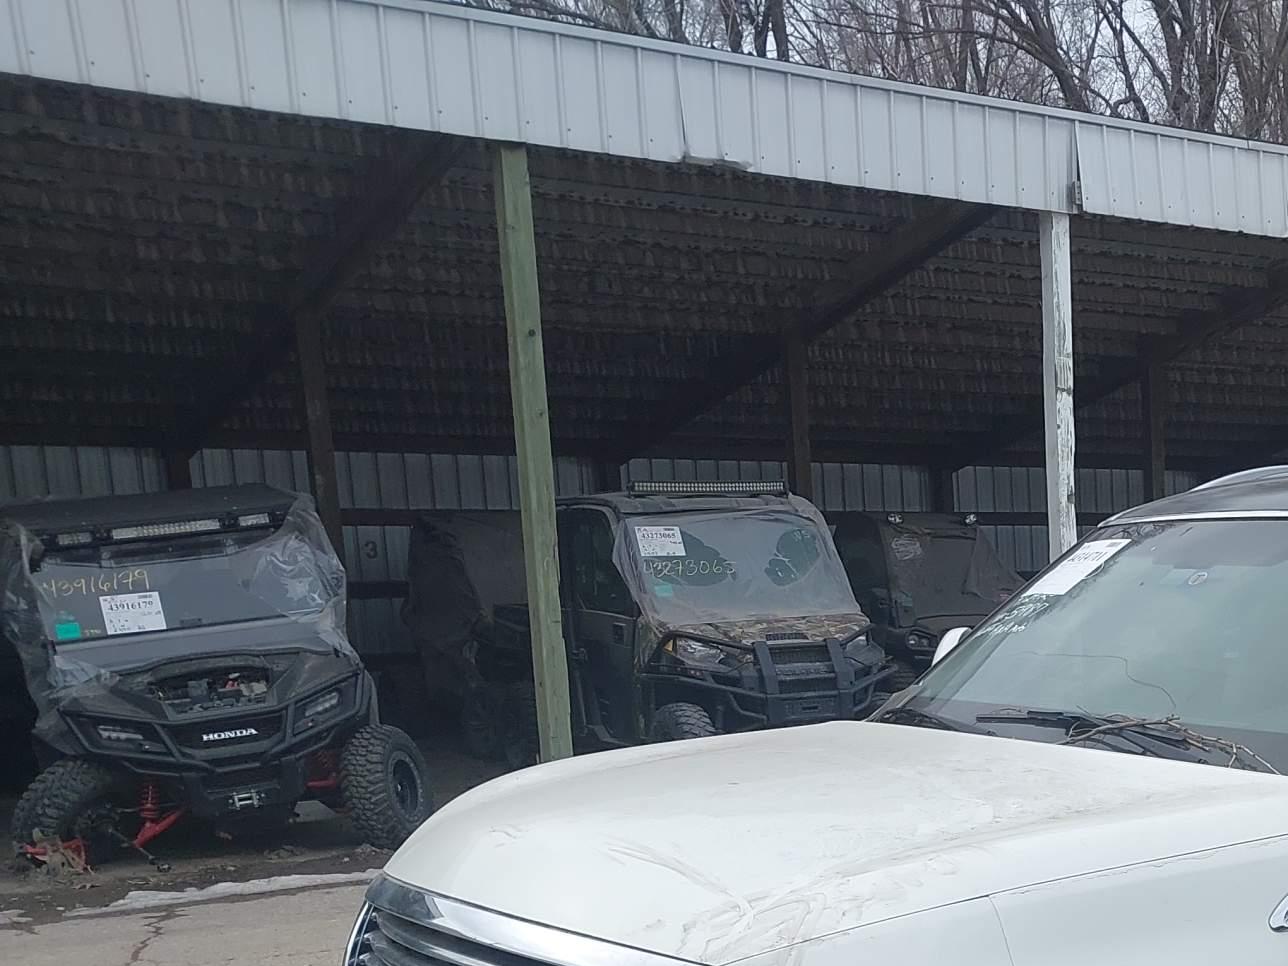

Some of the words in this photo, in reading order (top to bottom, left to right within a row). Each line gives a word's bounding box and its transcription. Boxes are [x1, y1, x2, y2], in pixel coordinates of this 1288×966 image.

[364, 541, 378, 559] 3
[643, 559, 737, 577] 43273065
[42, 569, 150, 598] 43916179
[201, 728, 258, 741] HONDA
